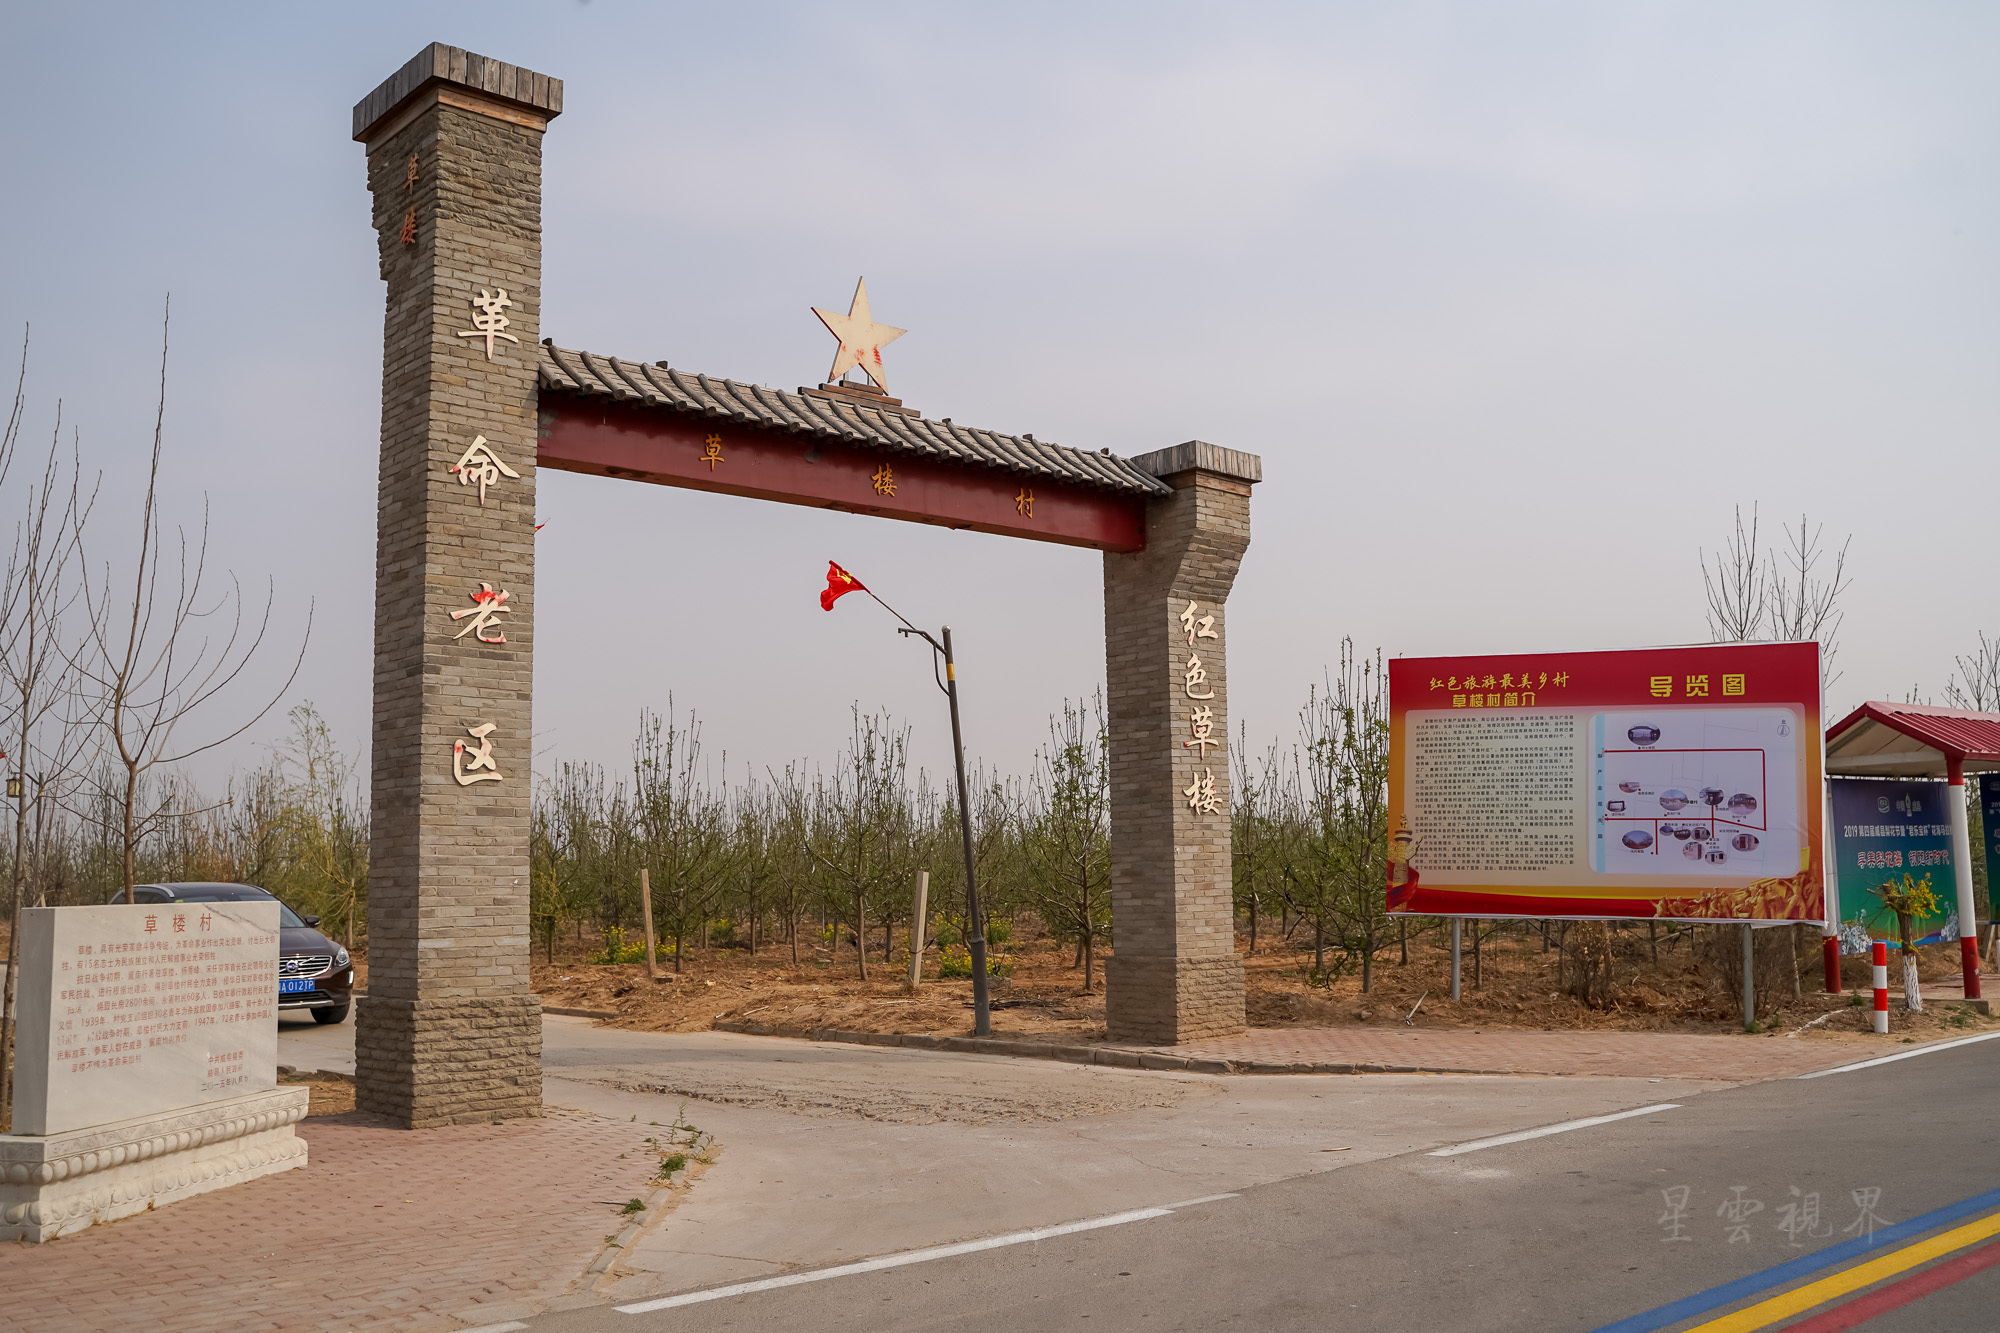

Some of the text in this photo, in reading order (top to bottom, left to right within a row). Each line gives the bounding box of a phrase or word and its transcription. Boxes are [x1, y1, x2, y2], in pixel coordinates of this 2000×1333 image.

[699, 433, 1036, 519] 草楼村
[448, 287, 520, 786] 革命老区
[1429, 671, 1570, 691] 红色旅游最美乡村
[1650, 673, 1746, 698] 导览图
[1179, 599, 1223, 816] 红色草楼
[1452, 691, 1536, 708] 草楼村简介
[1844, 825, 1858, 838] 2019
[144, 912, 213, 935] 草楼村
[279, 980, 315, 993] A012TP
